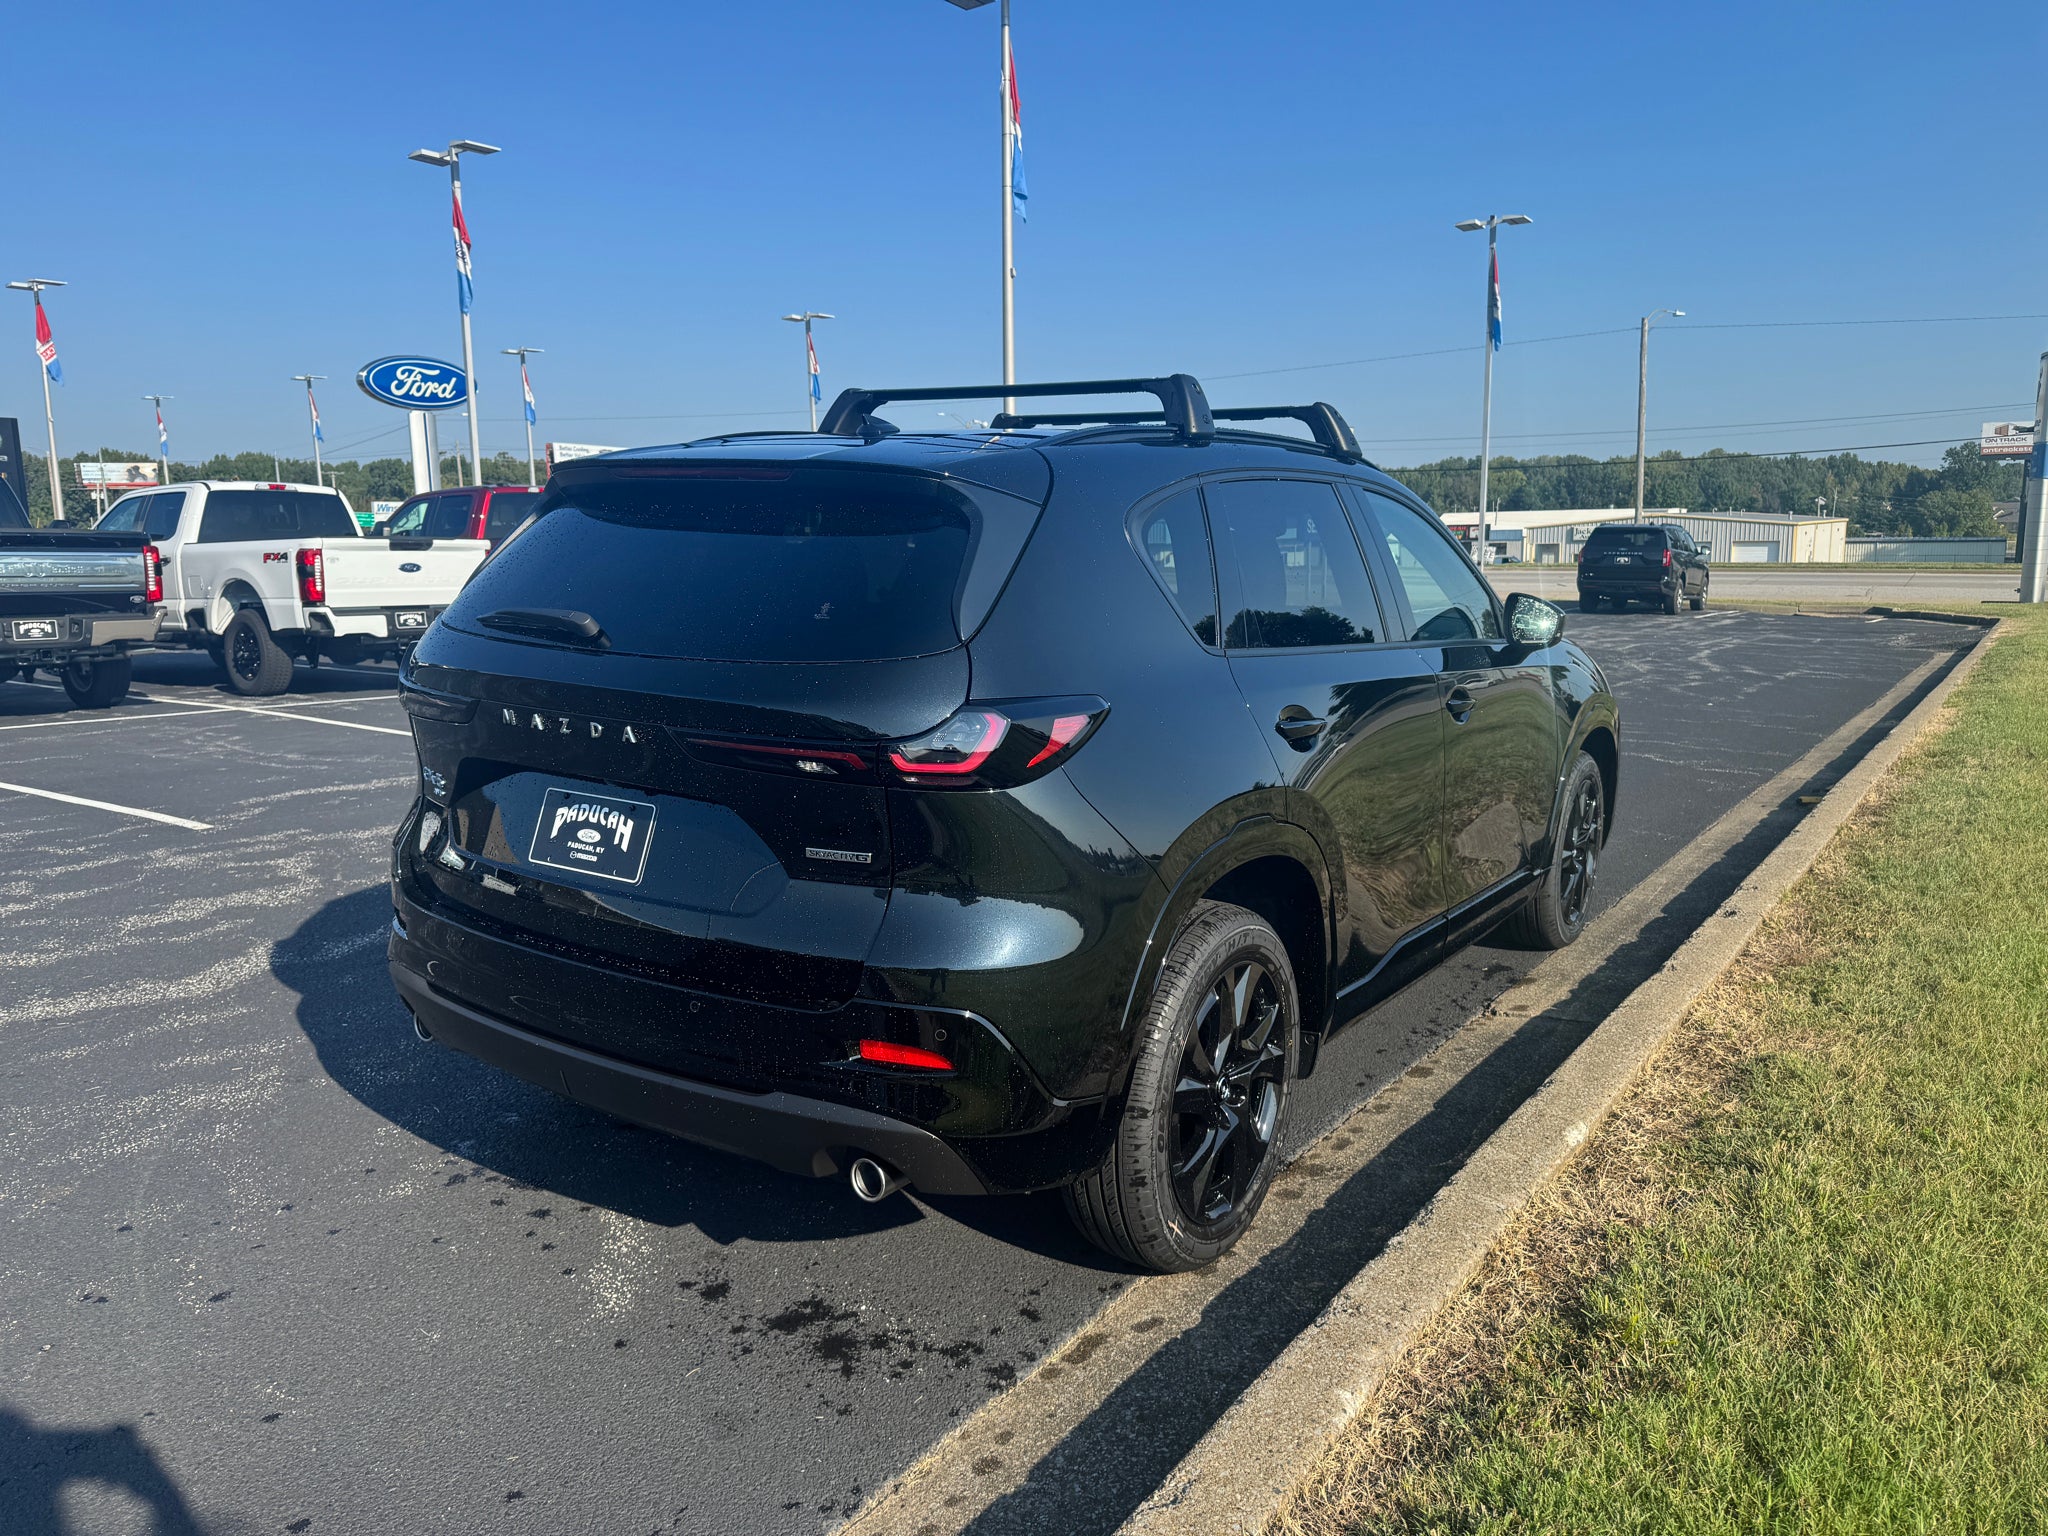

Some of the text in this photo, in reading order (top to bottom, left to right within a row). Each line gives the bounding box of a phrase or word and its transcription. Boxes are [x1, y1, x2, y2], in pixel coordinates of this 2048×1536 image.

[391, 365, 457, 399] Ford
[263, 551, 288, 564] FX4
[502, 708, 637, 744] MAZDA
[550, 803, 634, 853] PADUCAH
[567, 841, 605, 854] PADUCAH, KY
